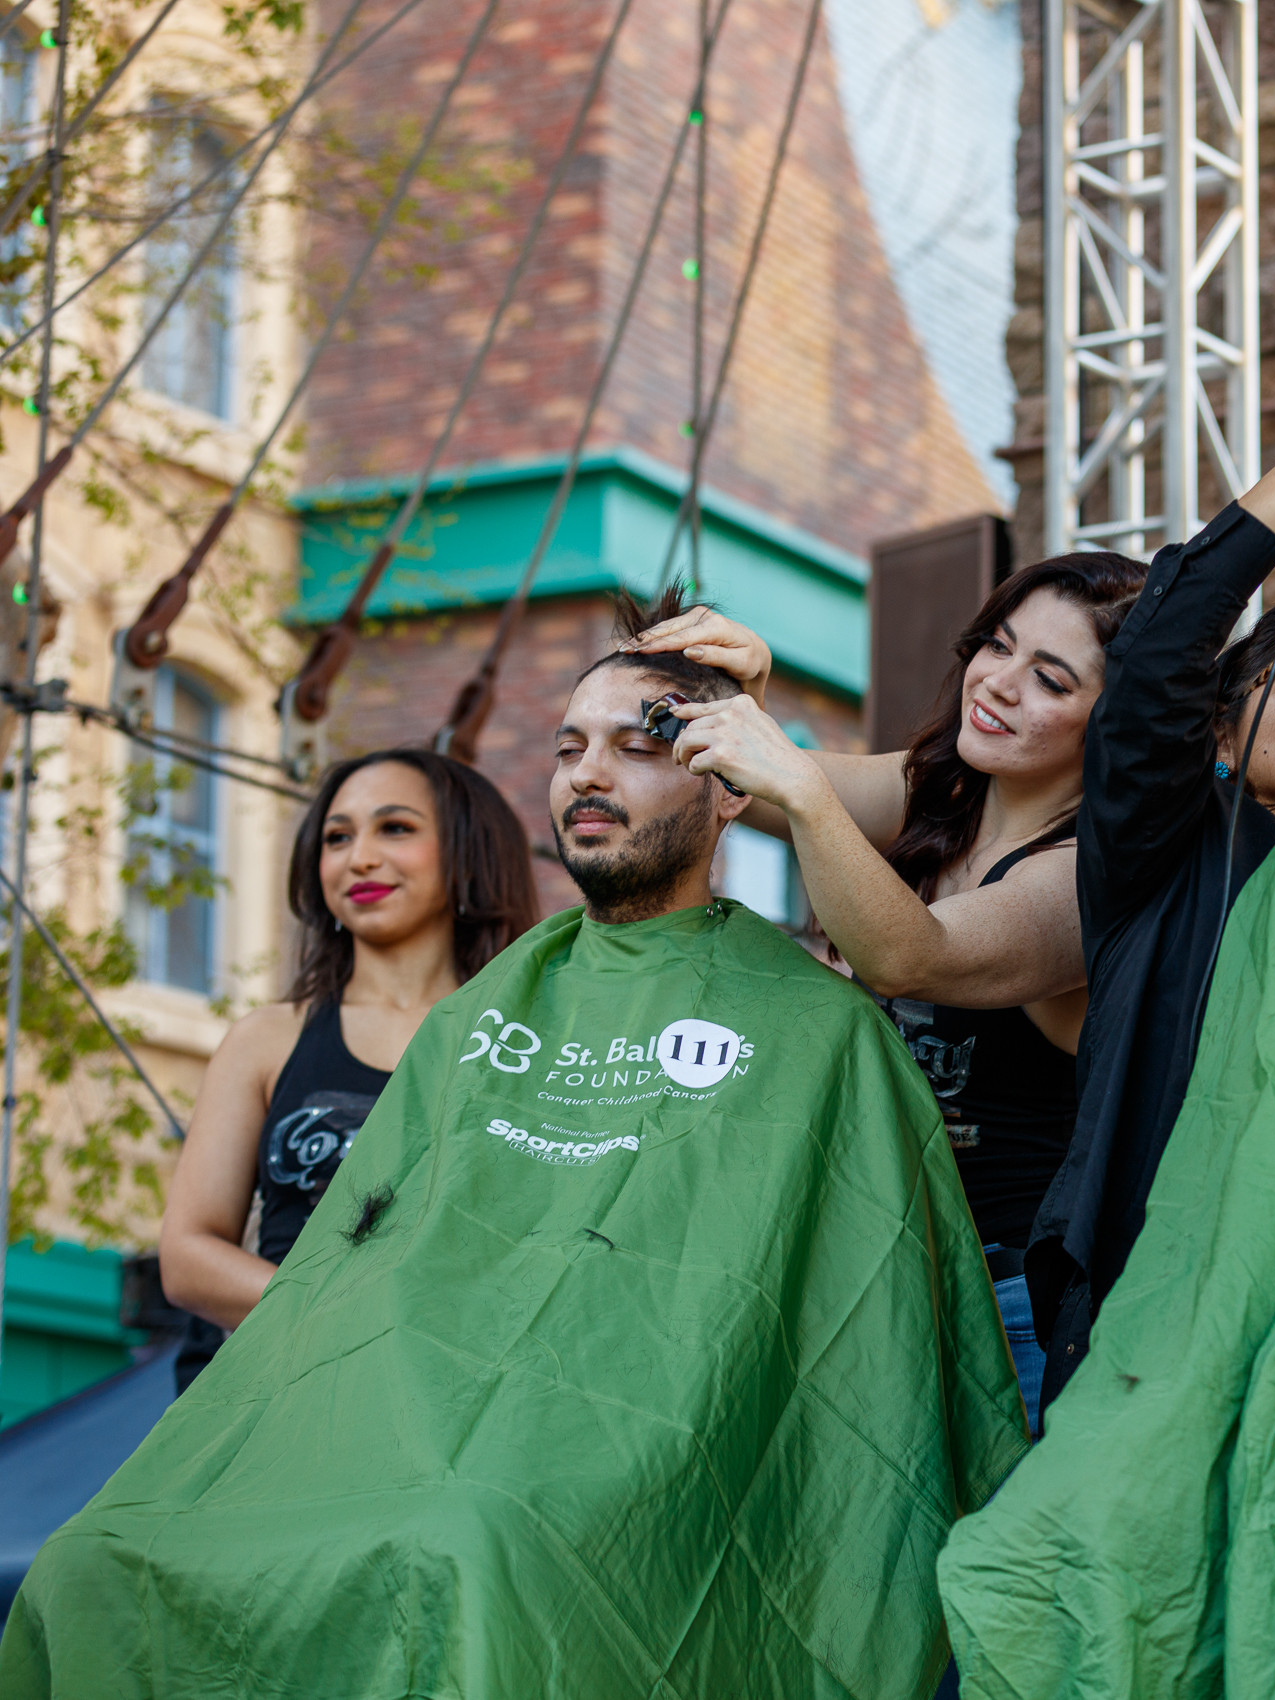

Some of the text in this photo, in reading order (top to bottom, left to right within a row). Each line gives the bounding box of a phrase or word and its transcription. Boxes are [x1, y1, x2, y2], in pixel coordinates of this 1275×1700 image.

[555, 1035, 754, 1067] St. Bal's
[667, 1034, 729, 1066] 111
[545, 1064, 750, 1088] FOUNDAN
[537, 1084, 717, 1106] Conquer Childhood Cancers
[486, 1118, 640, 1157] SportClips
[541, 1122, 611, 1140] National Partner
[512, 1142, 597, 1165] HAIRCUTS
